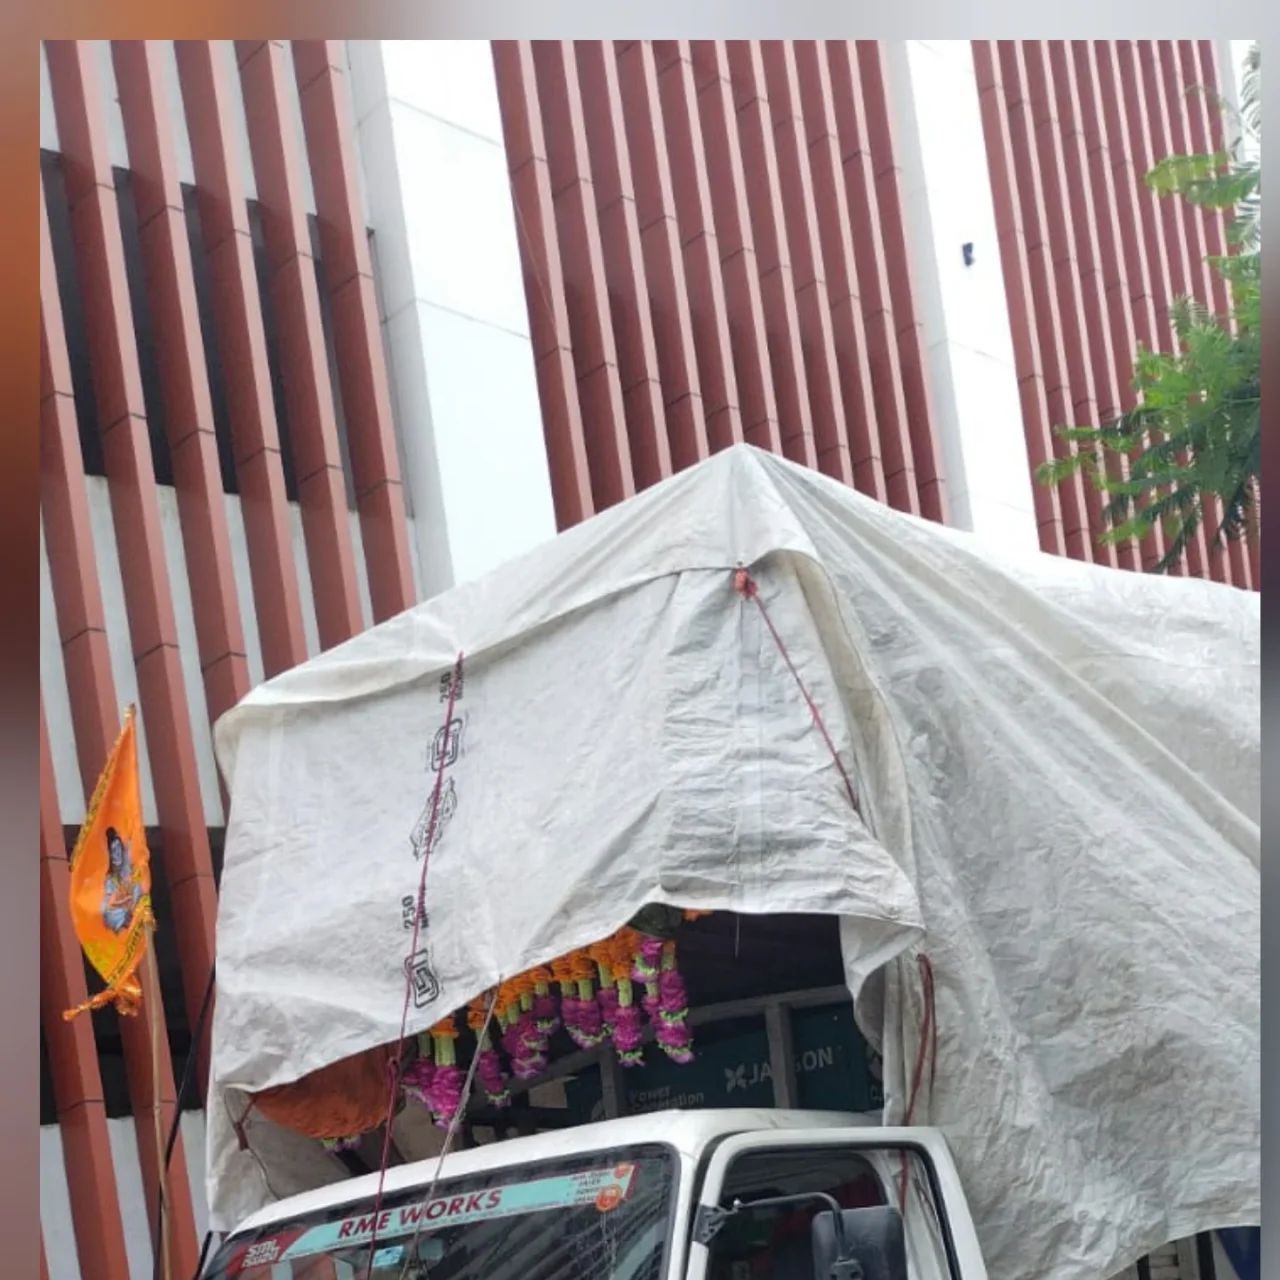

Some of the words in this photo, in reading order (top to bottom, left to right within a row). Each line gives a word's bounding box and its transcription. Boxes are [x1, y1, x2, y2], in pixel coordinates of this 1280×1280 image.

[748, 1046, 833, 1085] JAON
[337, 1211, 391, 1239] RME
[399, 1189, 503, 1226] WORKS
